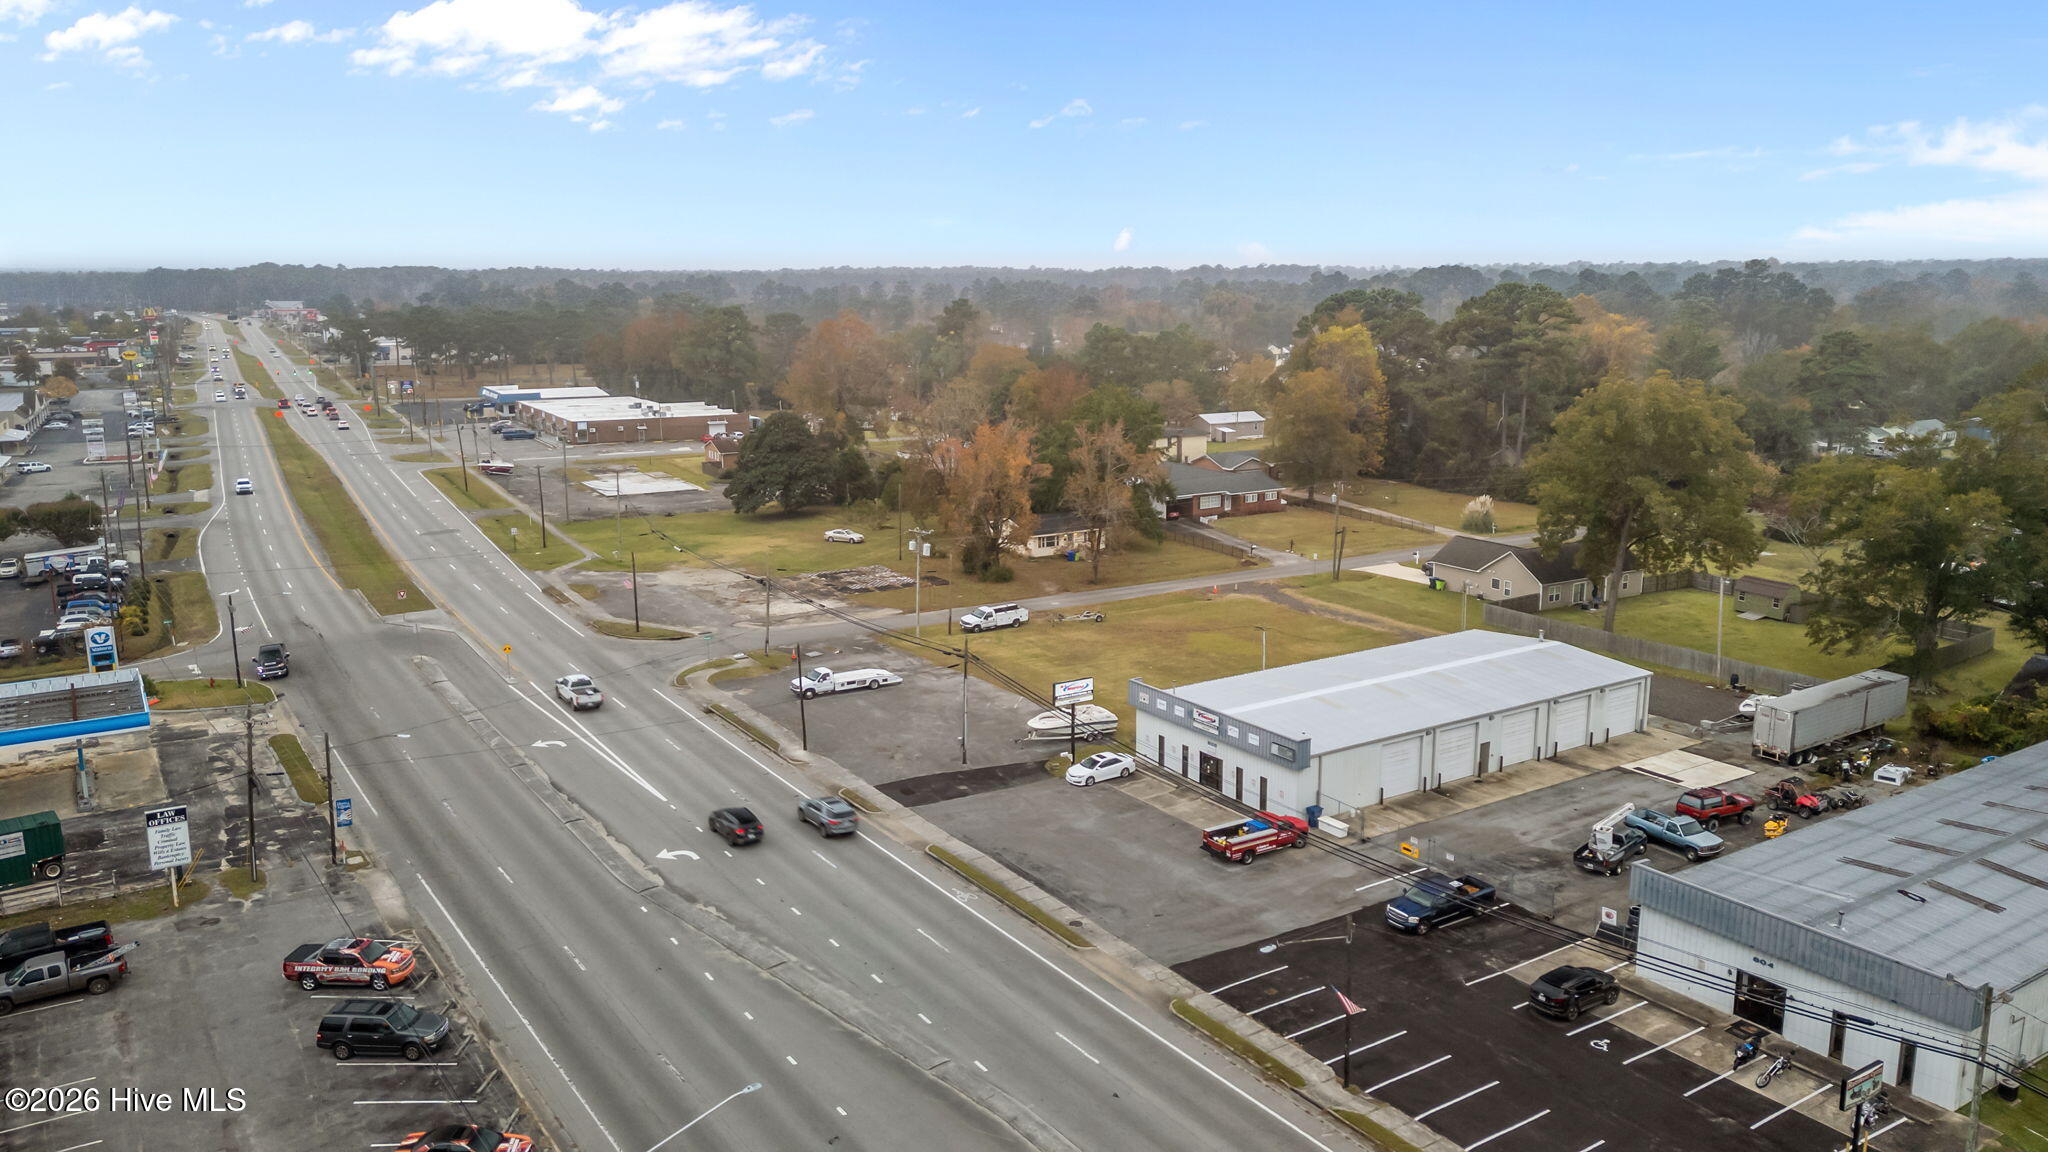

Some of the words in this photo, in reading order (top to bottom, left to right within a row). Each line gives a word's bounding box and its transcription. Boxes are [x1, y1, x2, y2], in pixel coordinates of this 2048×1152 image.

[157, 810, 175, 818] LAW
[148, 815, 185, 827] OFFICES
[351, 966, 386, 974] BONDING
